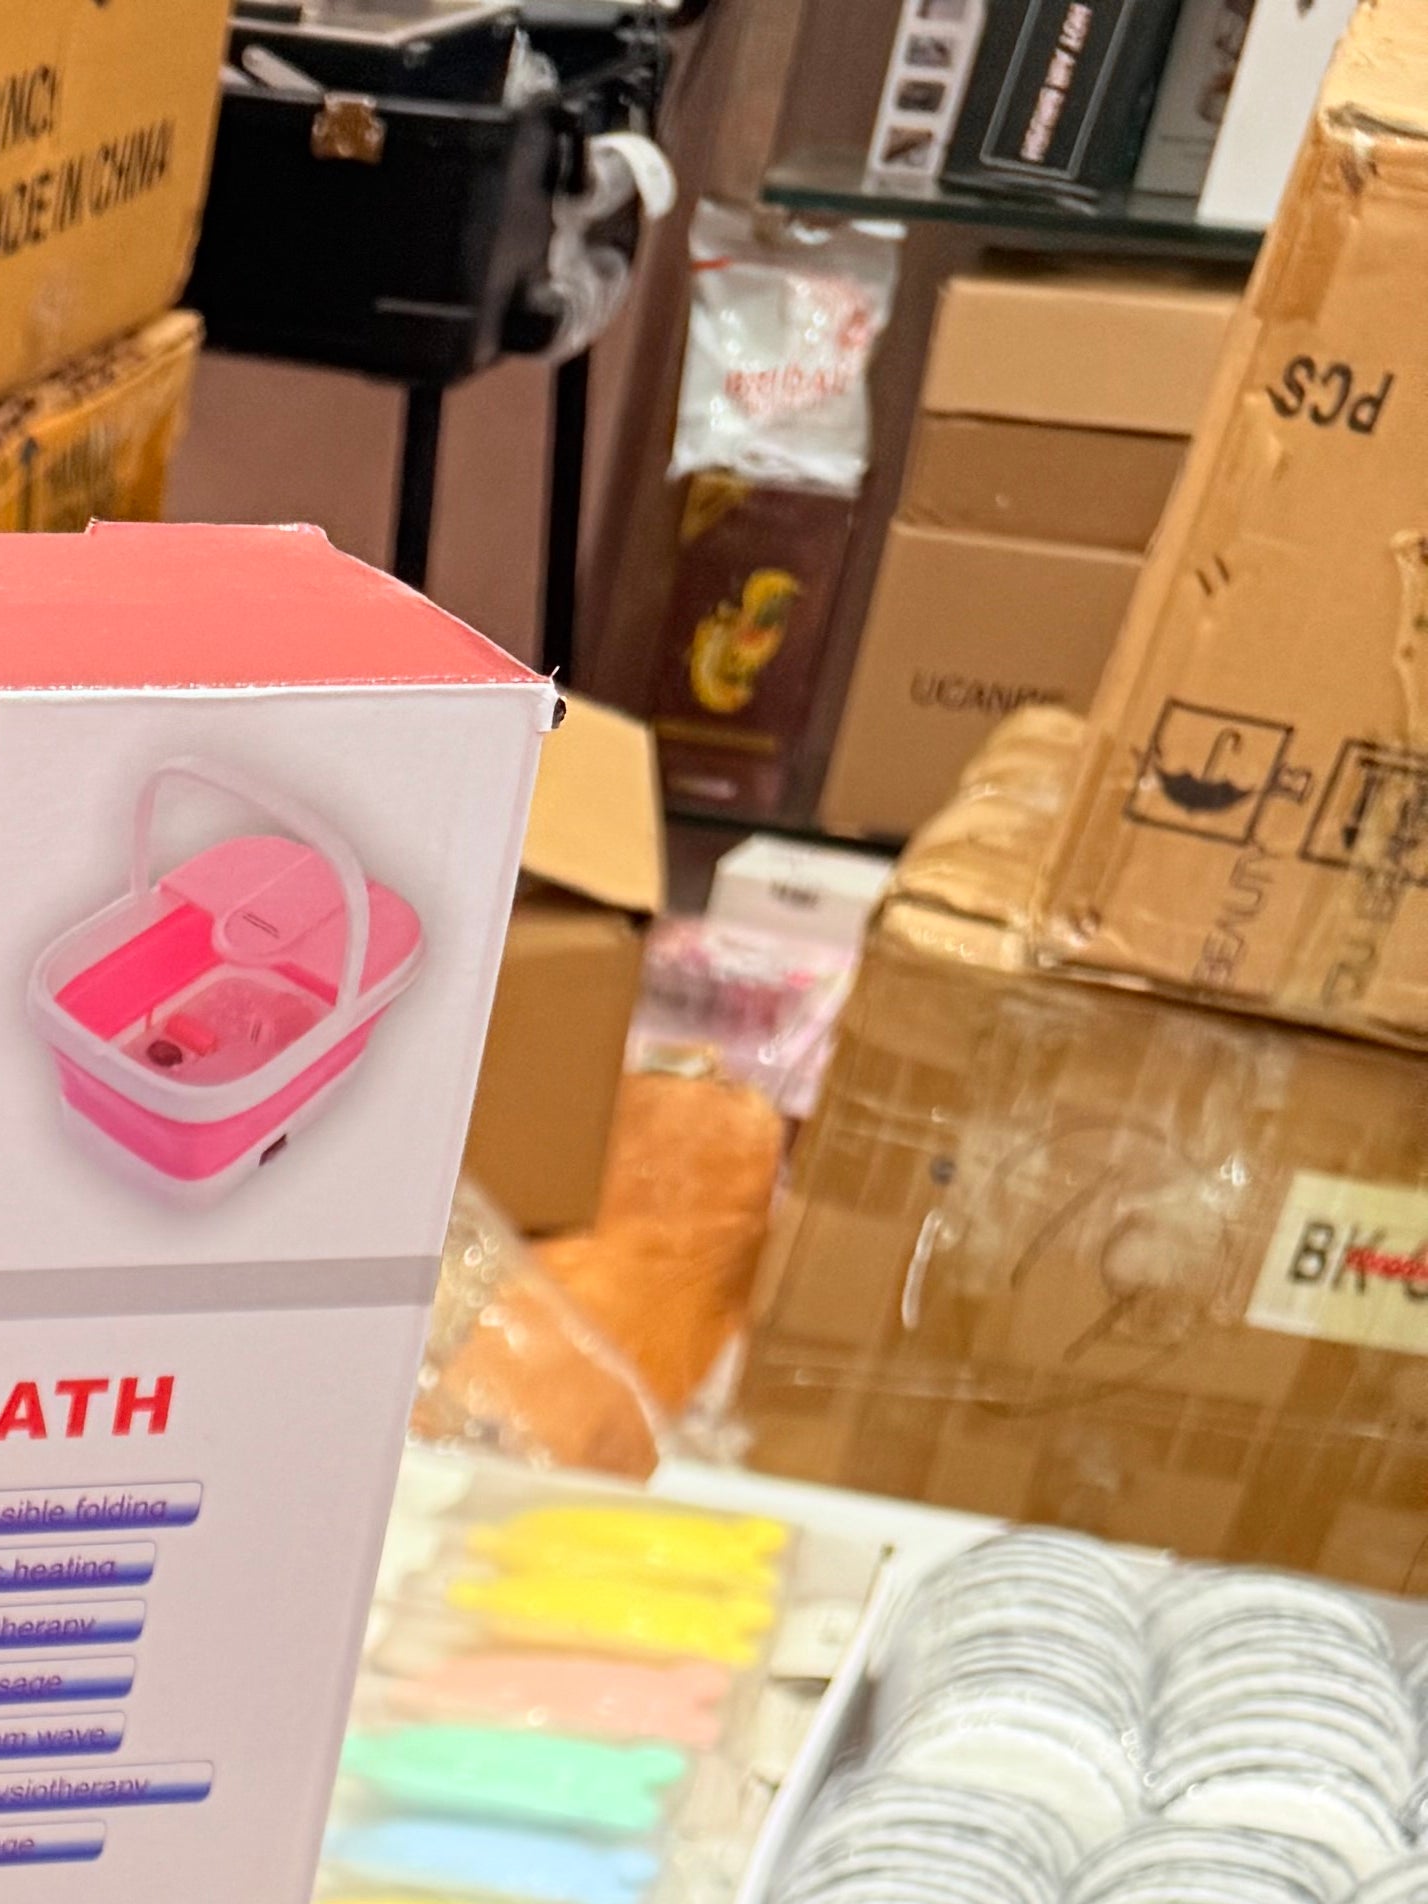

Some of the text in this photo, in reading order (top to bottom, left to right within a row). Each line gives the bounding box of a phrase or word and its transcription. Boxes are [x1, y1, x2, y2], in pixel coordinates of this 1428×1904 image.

[1266, 353, 1394, 436] PCS
[74, 1494, 168, 1521] folding
[13, 1553, 116, 1581] heating
[35, 1727, 106, 1746] wave
